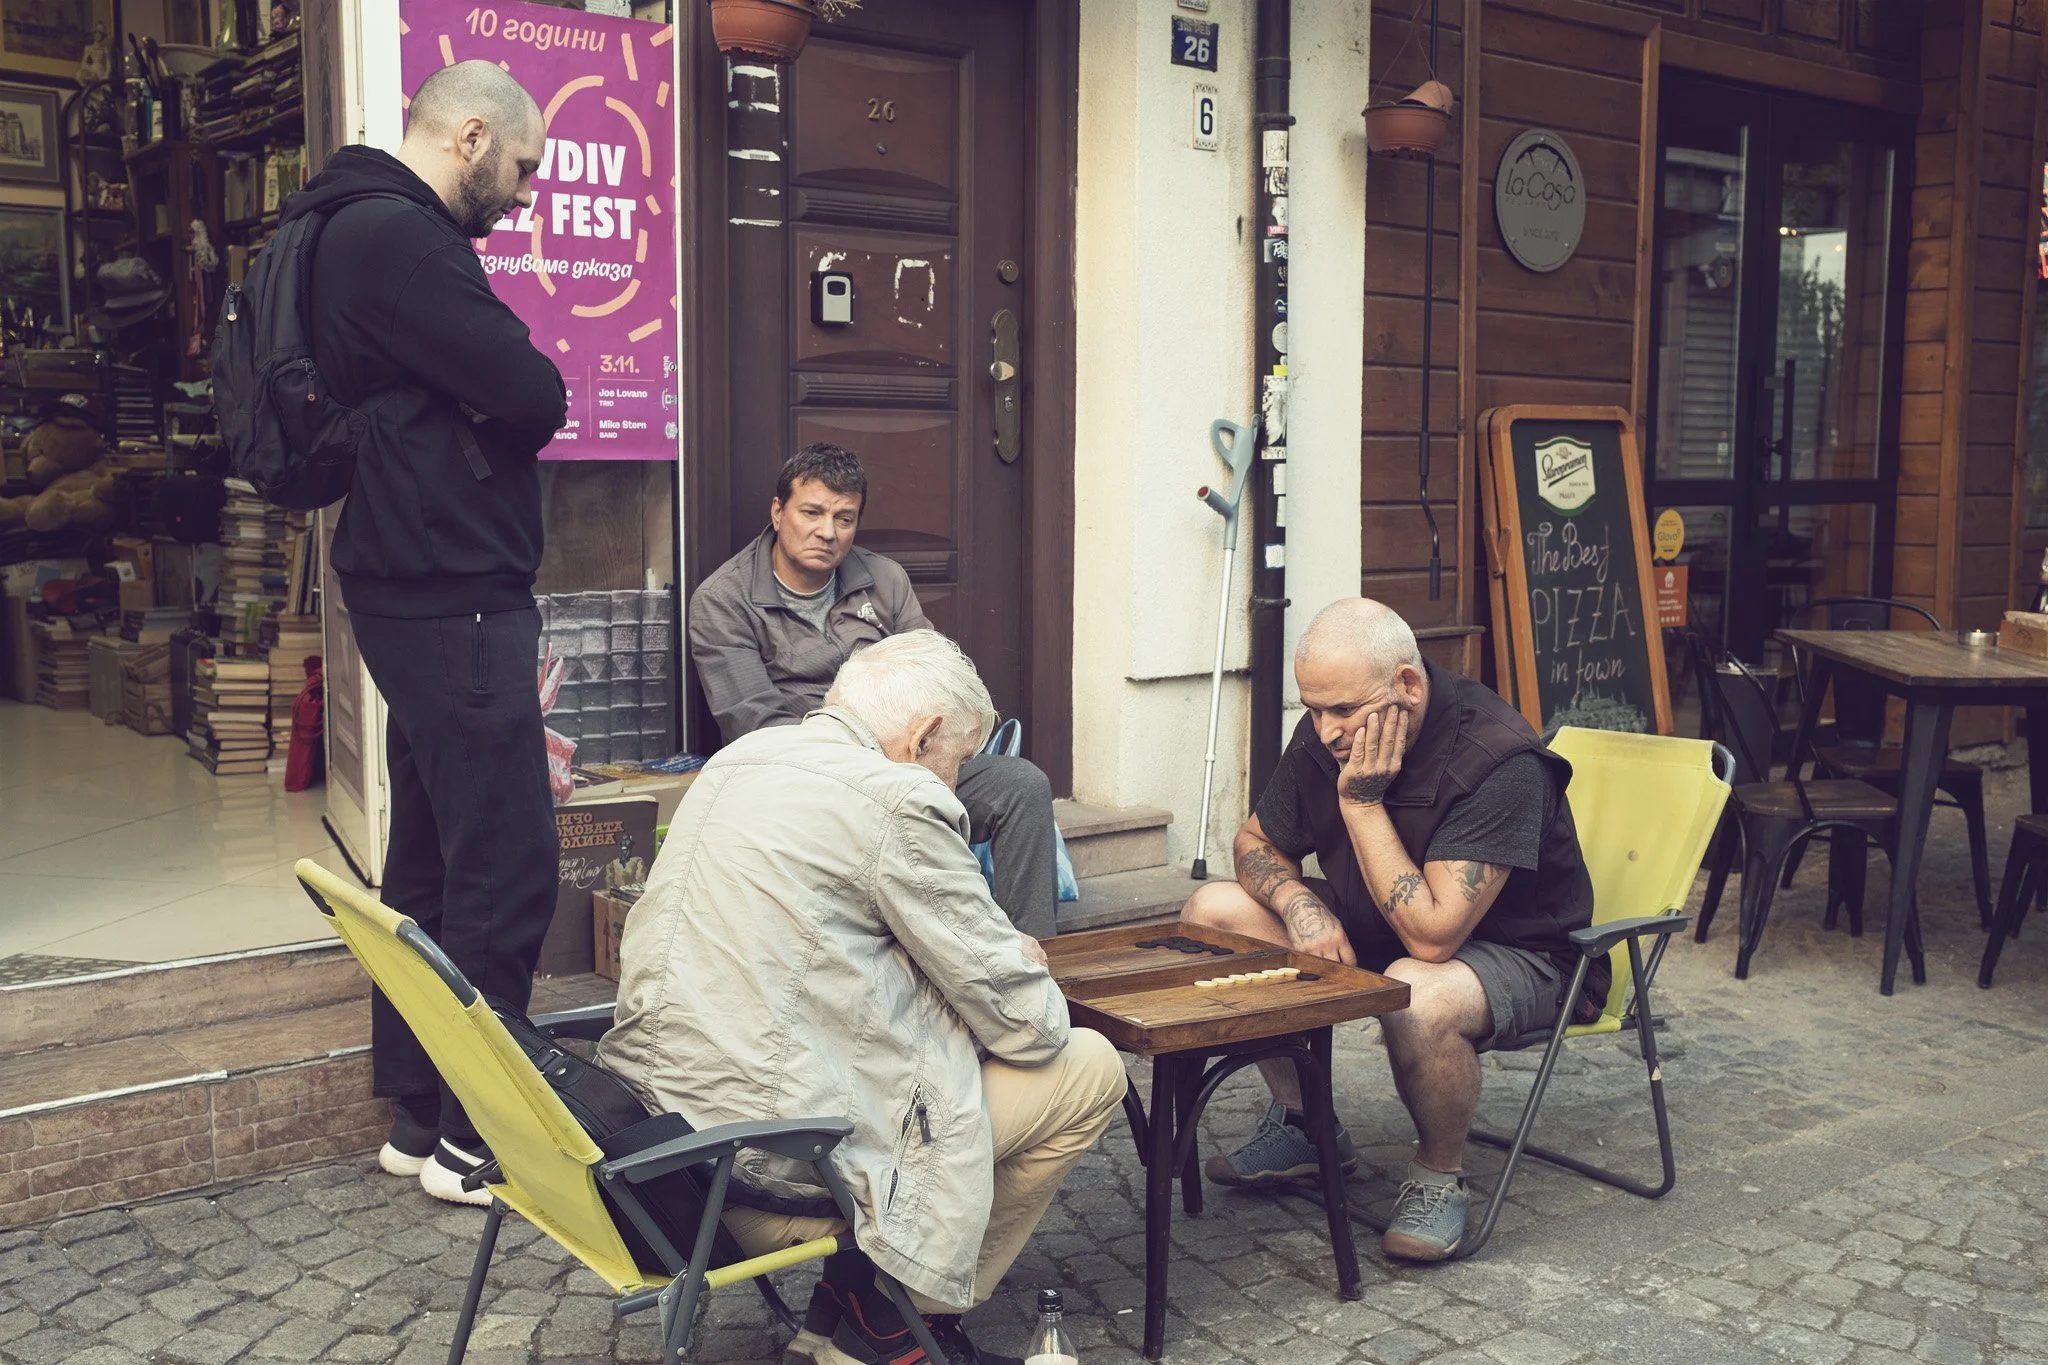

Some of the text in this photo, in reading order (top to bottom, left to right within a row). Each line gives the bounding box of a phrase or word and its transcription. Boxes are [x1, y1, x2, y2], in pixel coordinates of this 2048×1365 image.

[464, 8, 606, 53] 10 години
[1183, 35, 1210, 63] 26
[867, 97, 896, 121] 26
[1199, 97, 1214, 136] 6
[536, 138, 626, 187] VDIV
[551, 193, 637, 240] FEST
[478, 253, 633, 282] азнуваме джаза
[599, 354, 640, 374] 3.11.
[598, 388, 648, 398] Joe Lovano
[553, 432, 578, 440] ance
[599, 420, 647, 429] Mike Stern
[599, 431, 618, 439] BAND
[1526, 518, 1610, 583] The Best
[1531, 581, 1636, 654] PIZZA
[1550, 648, 1626, 705] in town
[557, 821, 625, 837] МОВАТА
[559, 833, 617, 849] ОЛИБА
